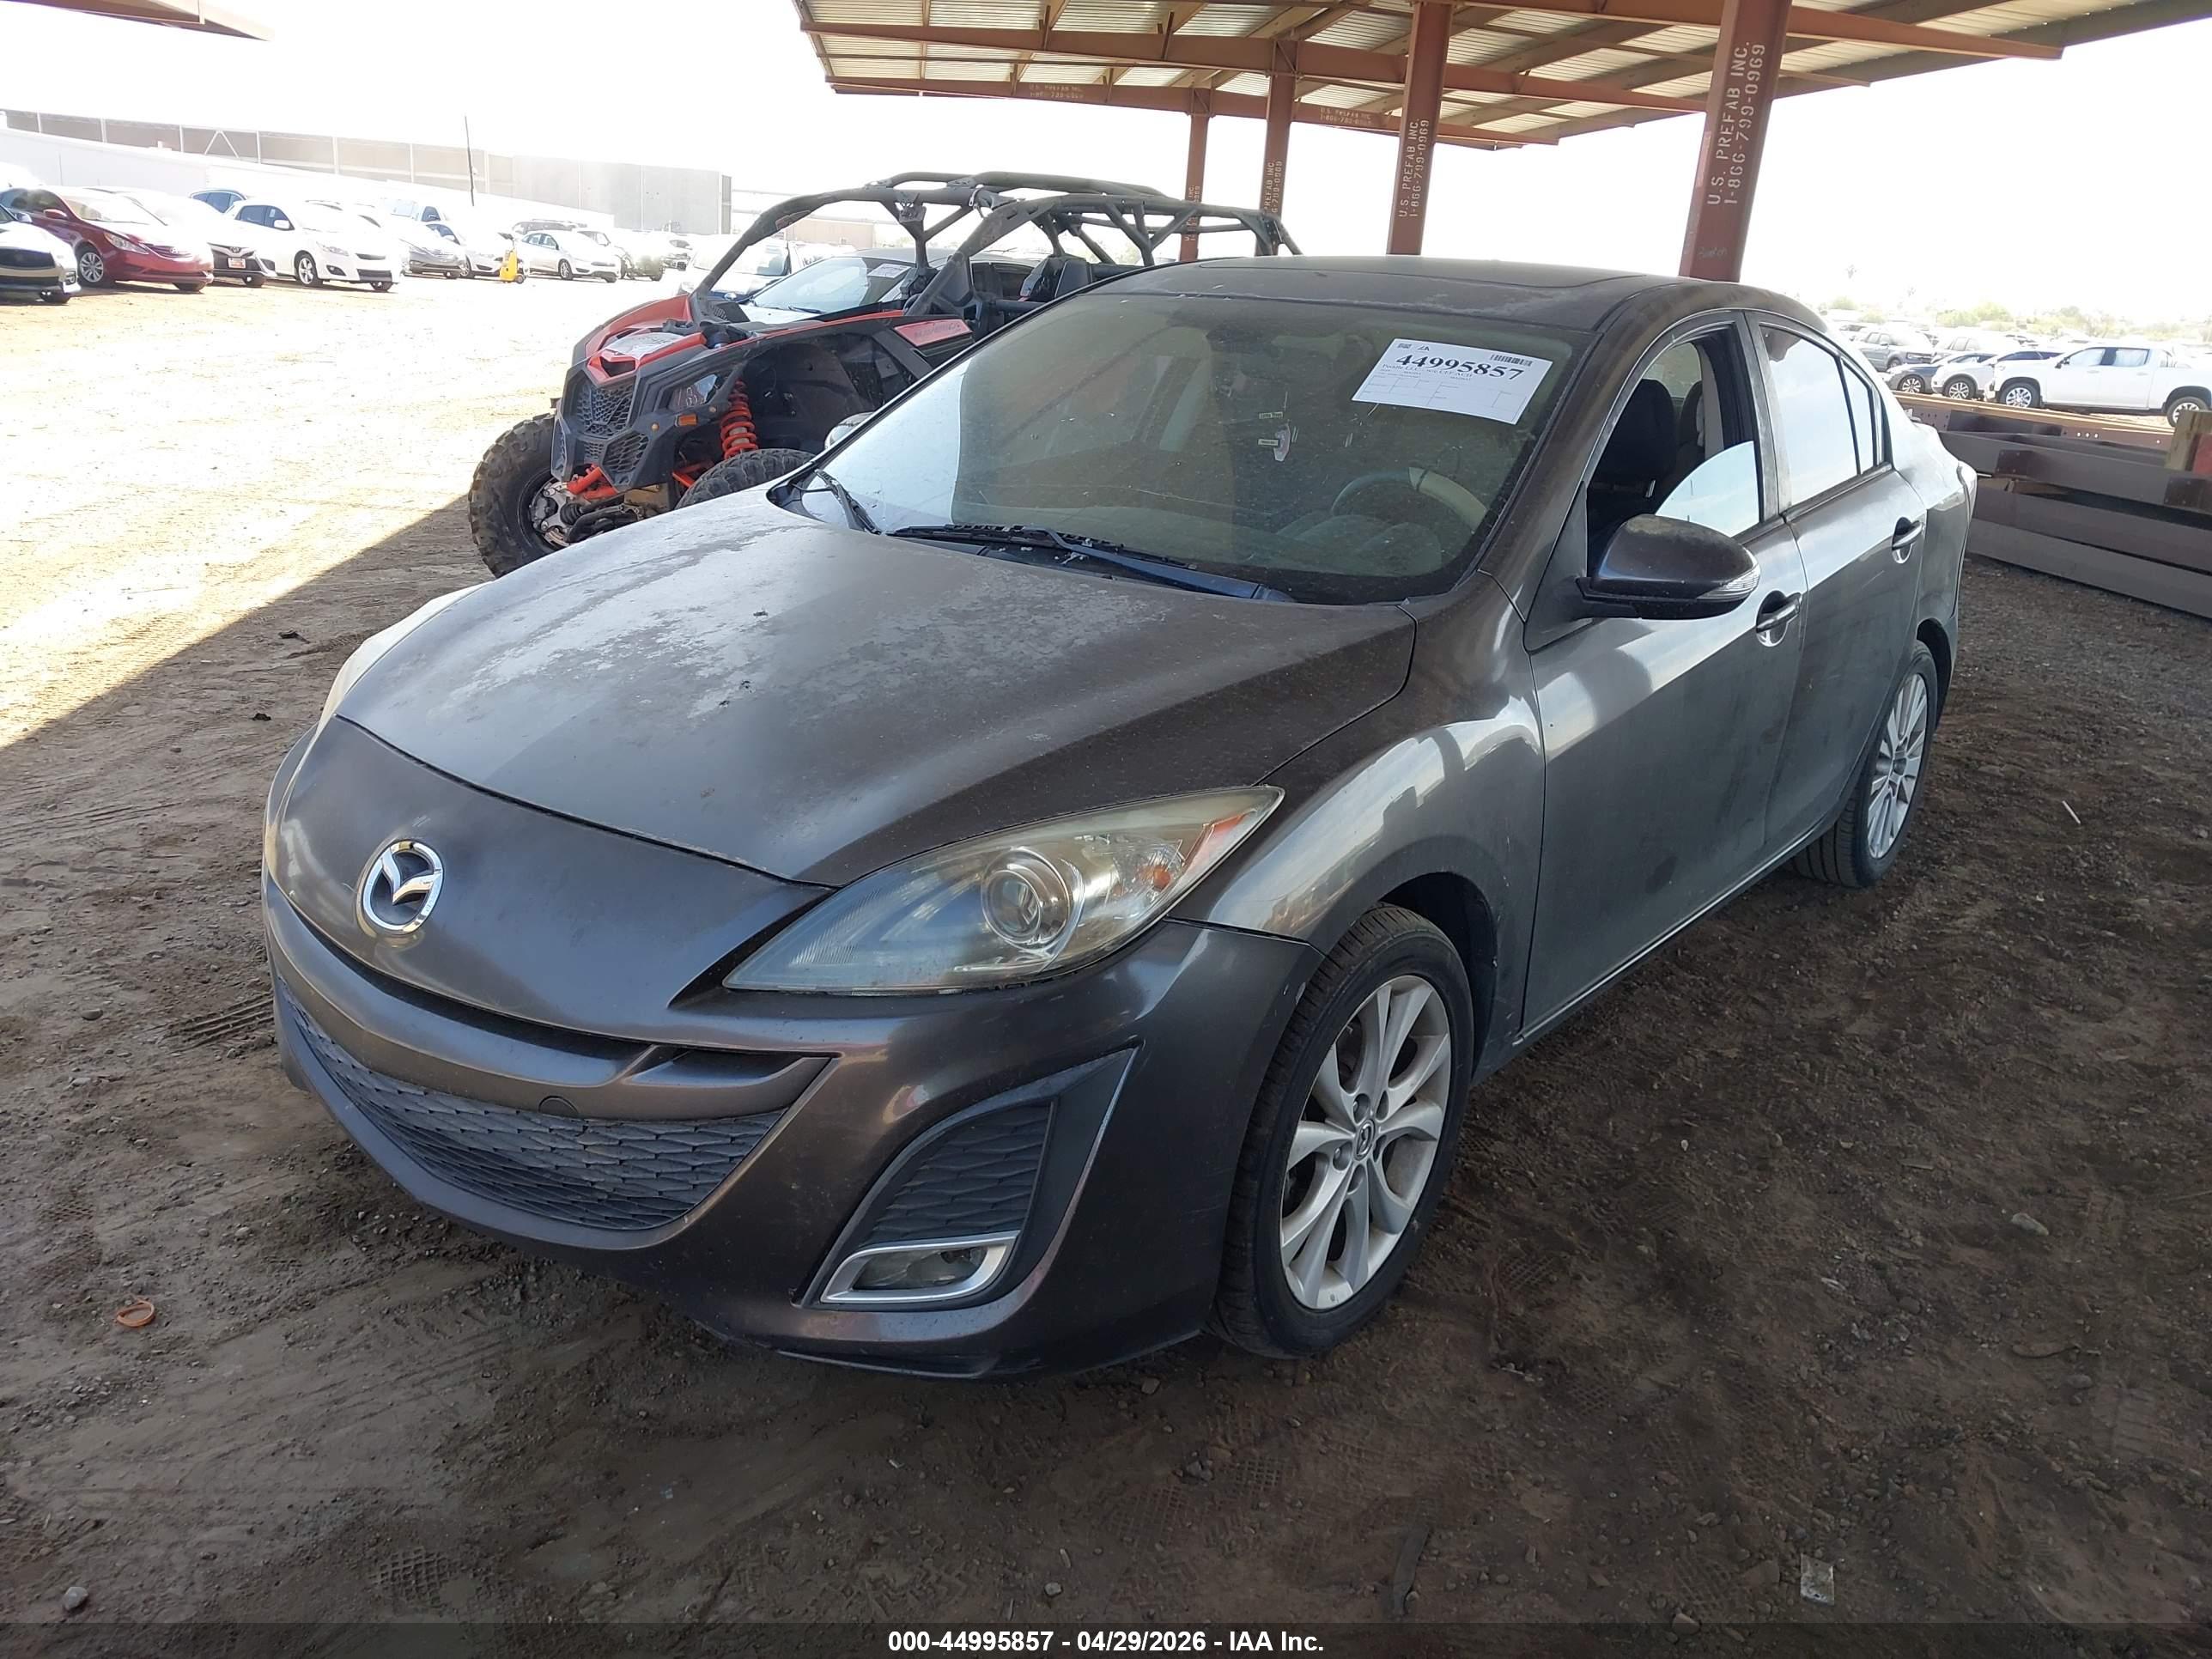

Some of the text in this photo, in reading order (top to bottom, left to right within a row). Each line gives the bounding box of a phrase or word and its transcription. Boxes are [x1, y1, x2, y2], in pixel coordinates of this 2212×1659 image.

[1398, 118, 1419, 217] U.S. PREFAB INC.
[1409, 119, 1430, 217] 1-866-799-0969
[1707, 42, 1749, 205] U.S. PREFAB INC.
[1724, 44, 1765, 204] 1-866-799-0969
[1395, 353, 1525, 380] 44995857
